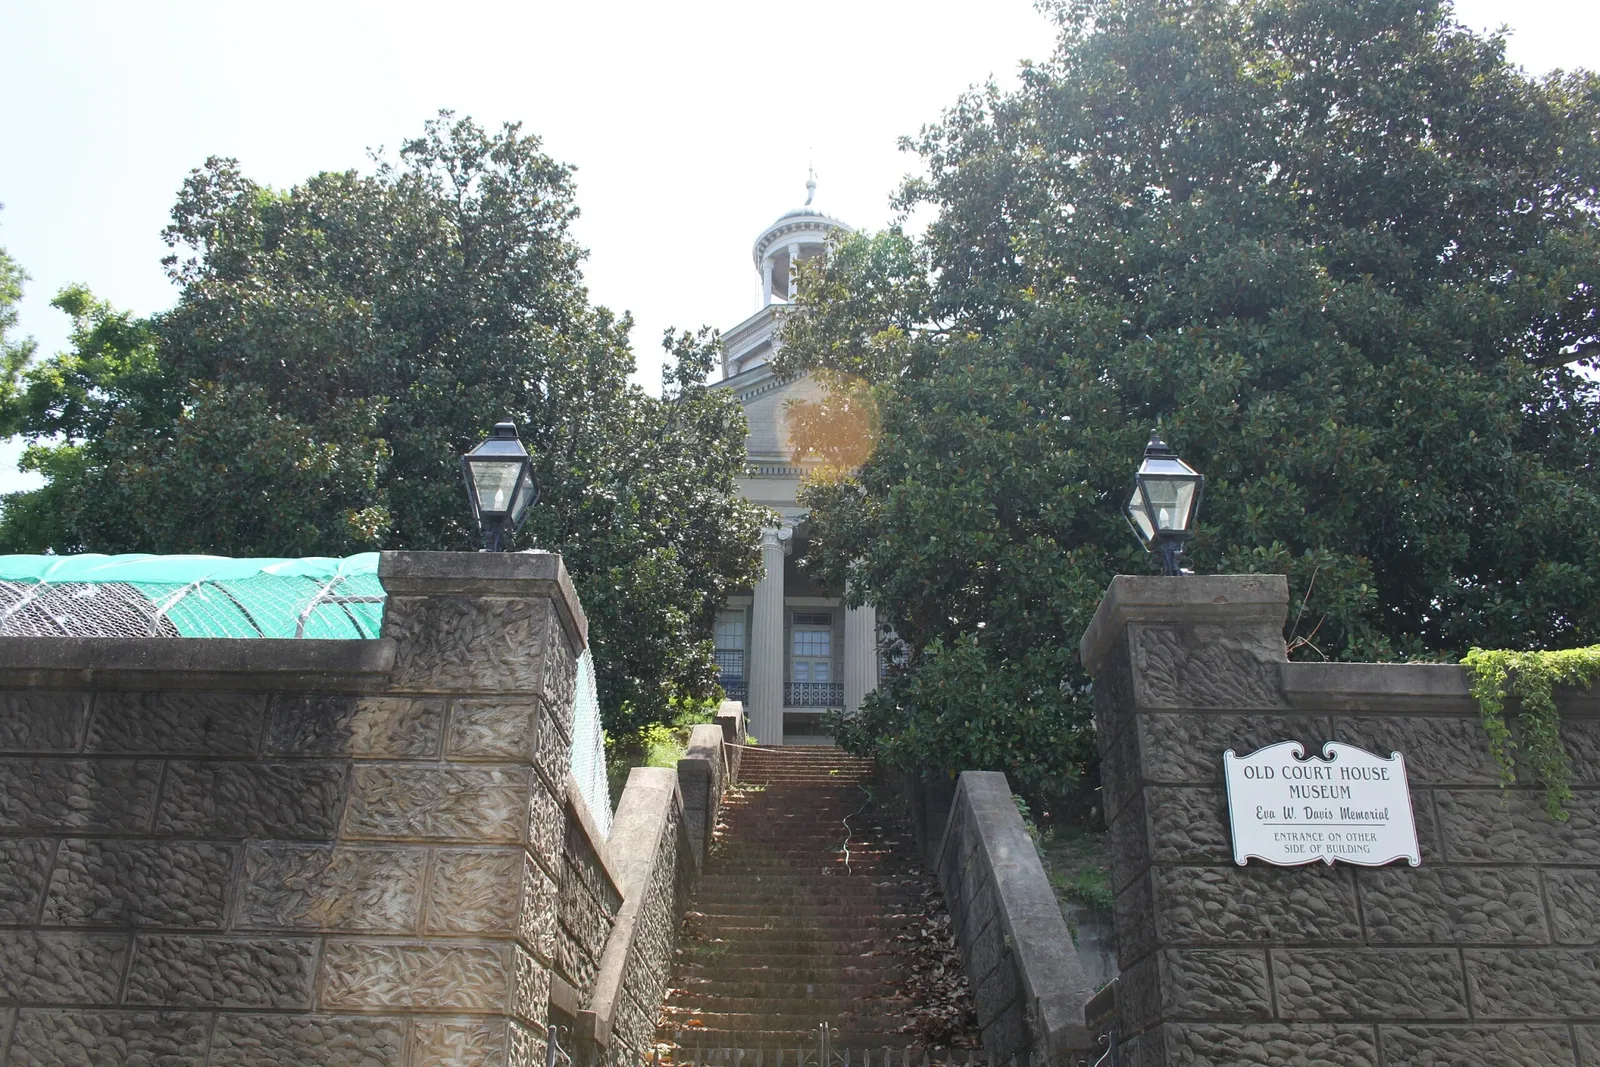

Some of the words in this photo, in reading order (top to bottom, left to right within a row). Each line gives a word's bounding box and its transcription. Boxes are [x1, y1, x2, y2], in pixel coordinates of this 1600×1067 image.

[1244, 766, 1275, 780] OLD
[1282, 766, 1332, 780] COURT
[1340, 767, 1390, 781] HOUSE
[1289, 785, 1352, 799] MUSEUM
[1256, 805, 1276, 820] Eva
[1283, 806, 1297, 820] W.
[1303, 806, 1334, 820] Davis
[1340, 807, 1390, 821] Memorial
[1274, 832, 1324, 842] ENTRANCE
[1328, 833, 1342, 842] ON
[1346, 833, 1377, 842] OTHER
[1284, 844, 1306, 853] SIDE
[1309, 844, 1322, 853] OF
[1326, 844, 1371, 854] BUILDING
